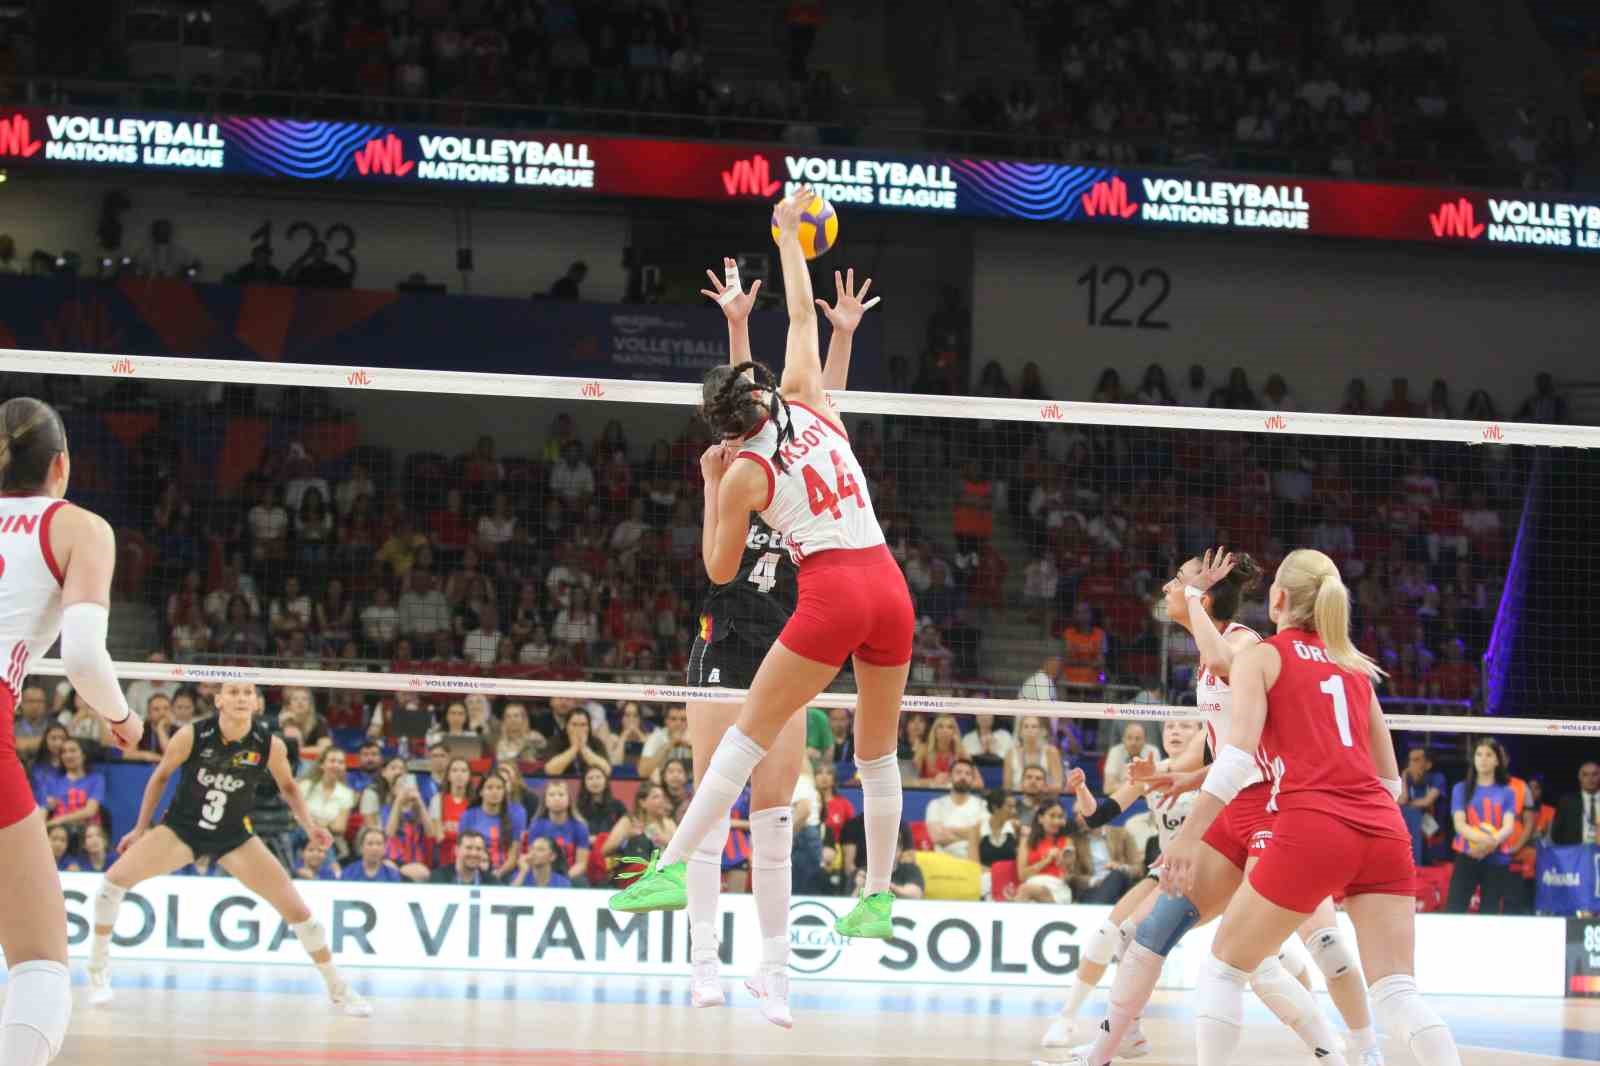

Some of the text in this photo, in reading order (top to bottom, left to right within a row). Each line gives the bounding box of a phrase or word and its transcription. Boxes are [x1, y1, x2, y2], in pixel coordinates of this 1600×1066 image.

[46, 115, 224, 147] VOLLEYBALL
[46, 141, 224, 168] NATIONS LEAGUE
[418, 135, 594, 167] VOLLEYBALL
[418, 161, 594, 187] NATIONS LEAGUE
[785, 156, 957, 189] VOLLEYBALL
[879, 189, 957, 209] LEAGUE
[1142, 178, 1309, 210] VOLLEYBALL
[1142, 203, 1309, 229] NATIONS LEAGUE
[1488, 199, 1600, 229] VOLLEYB
[250, 218, 357, 281] 123
[1488, 224, 1571, 246] NATIONS
[1077, 264, 1171, 329] 122
[612, 336, 727, 355] VOLLEYBALL
[801, 449, 865, 520] 44
[0, 514, 38, 535] IN
[748, 552, 781, 593] 4
[188, 669, 242, 678] VOLLEYBALL
[425, 679, 479, 689] VOLLEYBALL
[660, 690, 713, 698] VOLLEYBALL
[901, 700, 944, 708] LLEYBALL
[1319, 674, 1353, 747] 1
[201, 790, 227, 823] 3
[879, 917, 1081, 975] SOLG
